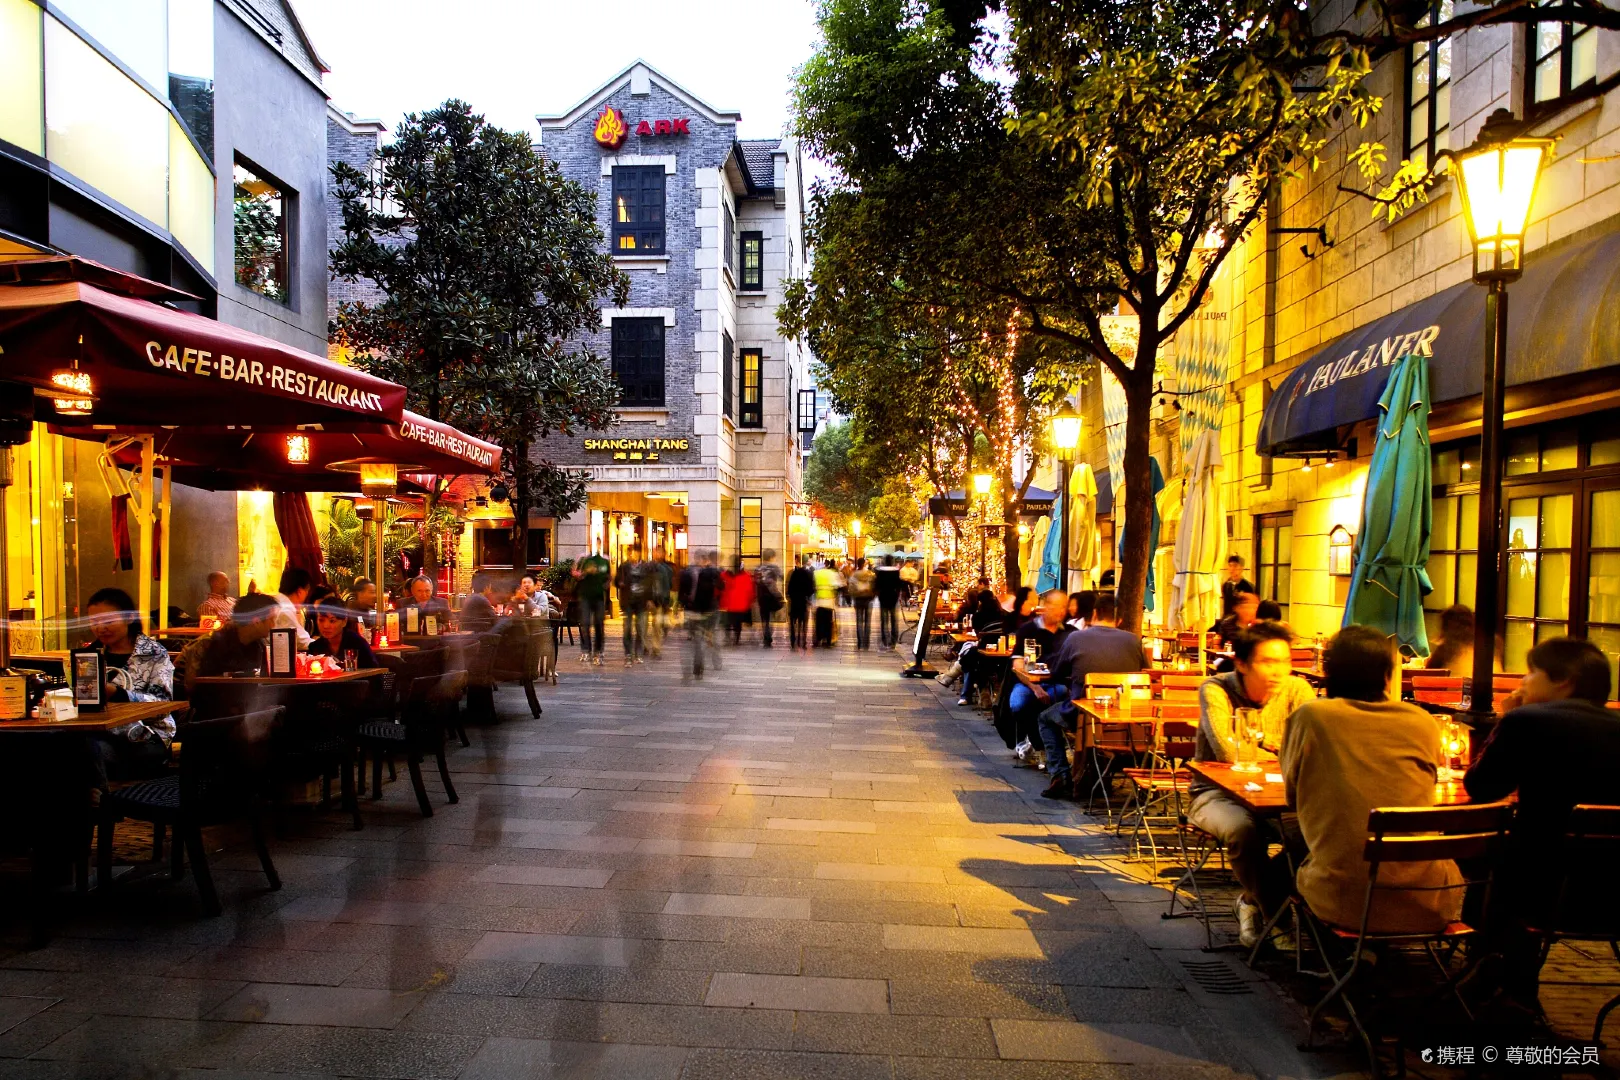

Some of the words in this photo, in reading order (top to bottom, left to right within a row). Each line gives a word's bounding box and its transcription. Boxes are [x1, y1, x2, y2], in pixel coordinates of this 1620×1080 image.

[635, 118, 690, 135] ARK
[1304, 324, 1441, 397] PAULANER
[584, 439, 652, 450] SHANGHAI
[653, 439, 689, 450] TANG
